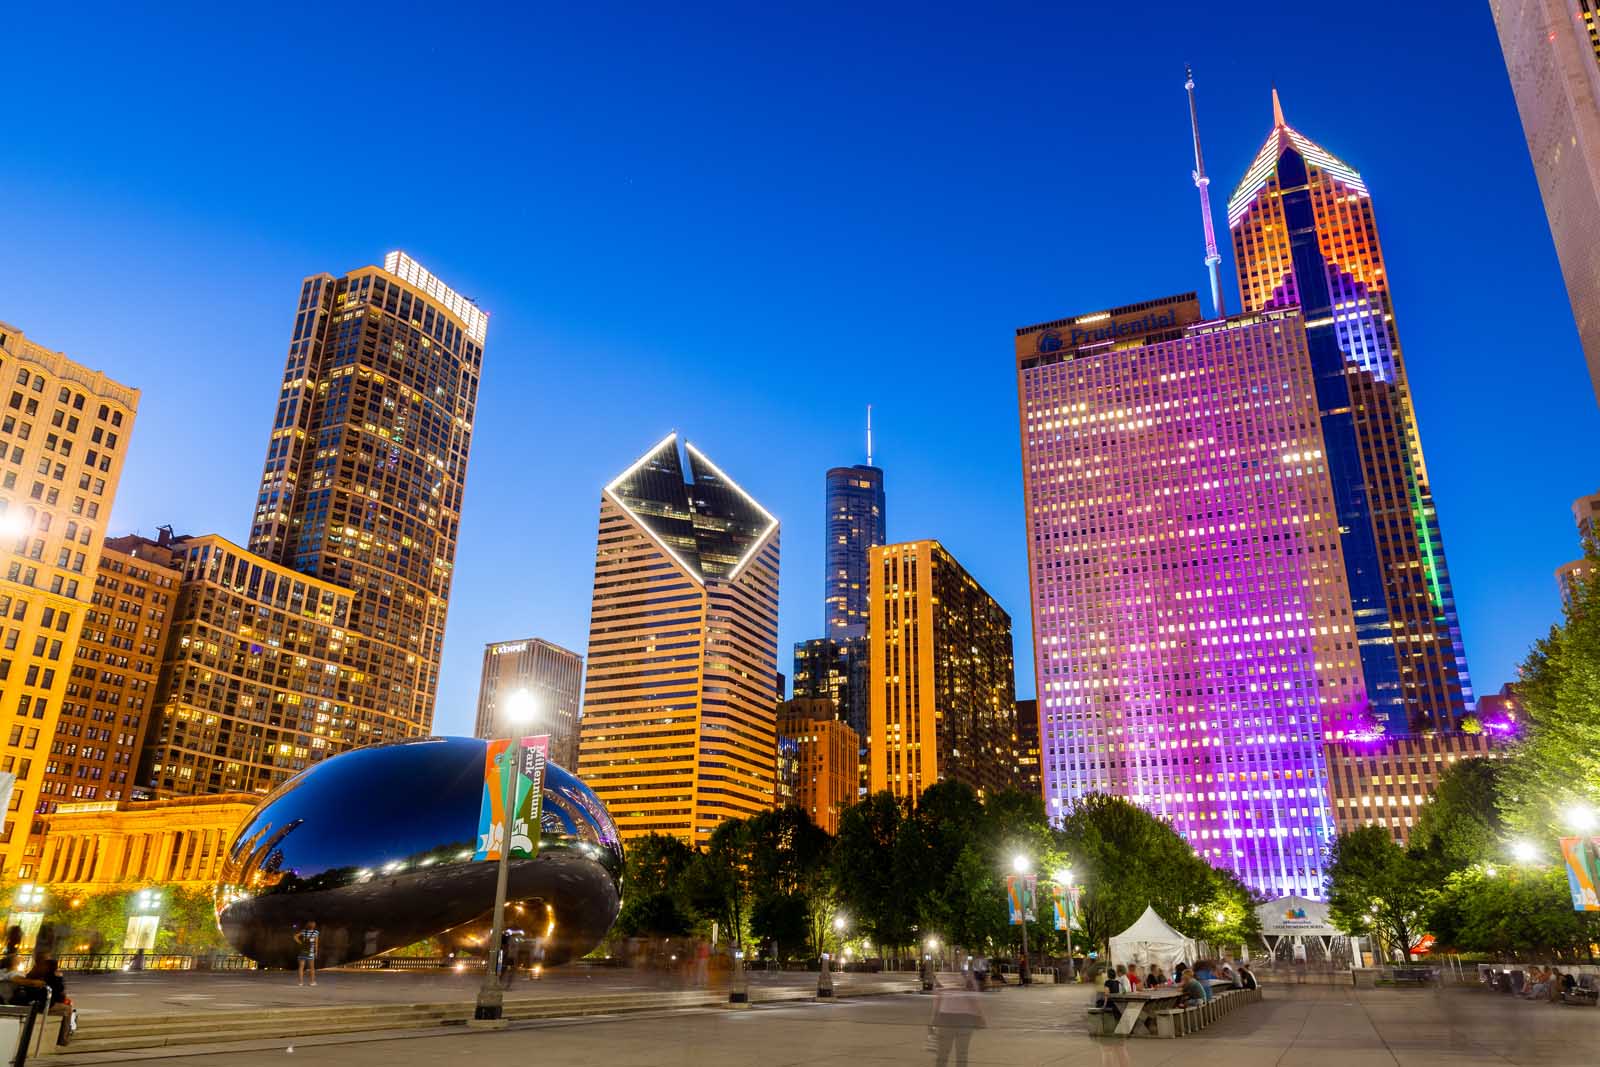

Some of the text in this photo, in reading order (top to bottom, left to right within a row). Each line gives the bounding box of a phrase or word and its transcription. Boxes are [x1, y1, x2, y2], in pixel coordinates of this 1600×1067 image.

[1070, 310, 1177, 345] Prudential
[525, 745, 536, 775] Park
[530, 744, 546, 820] Millennium
